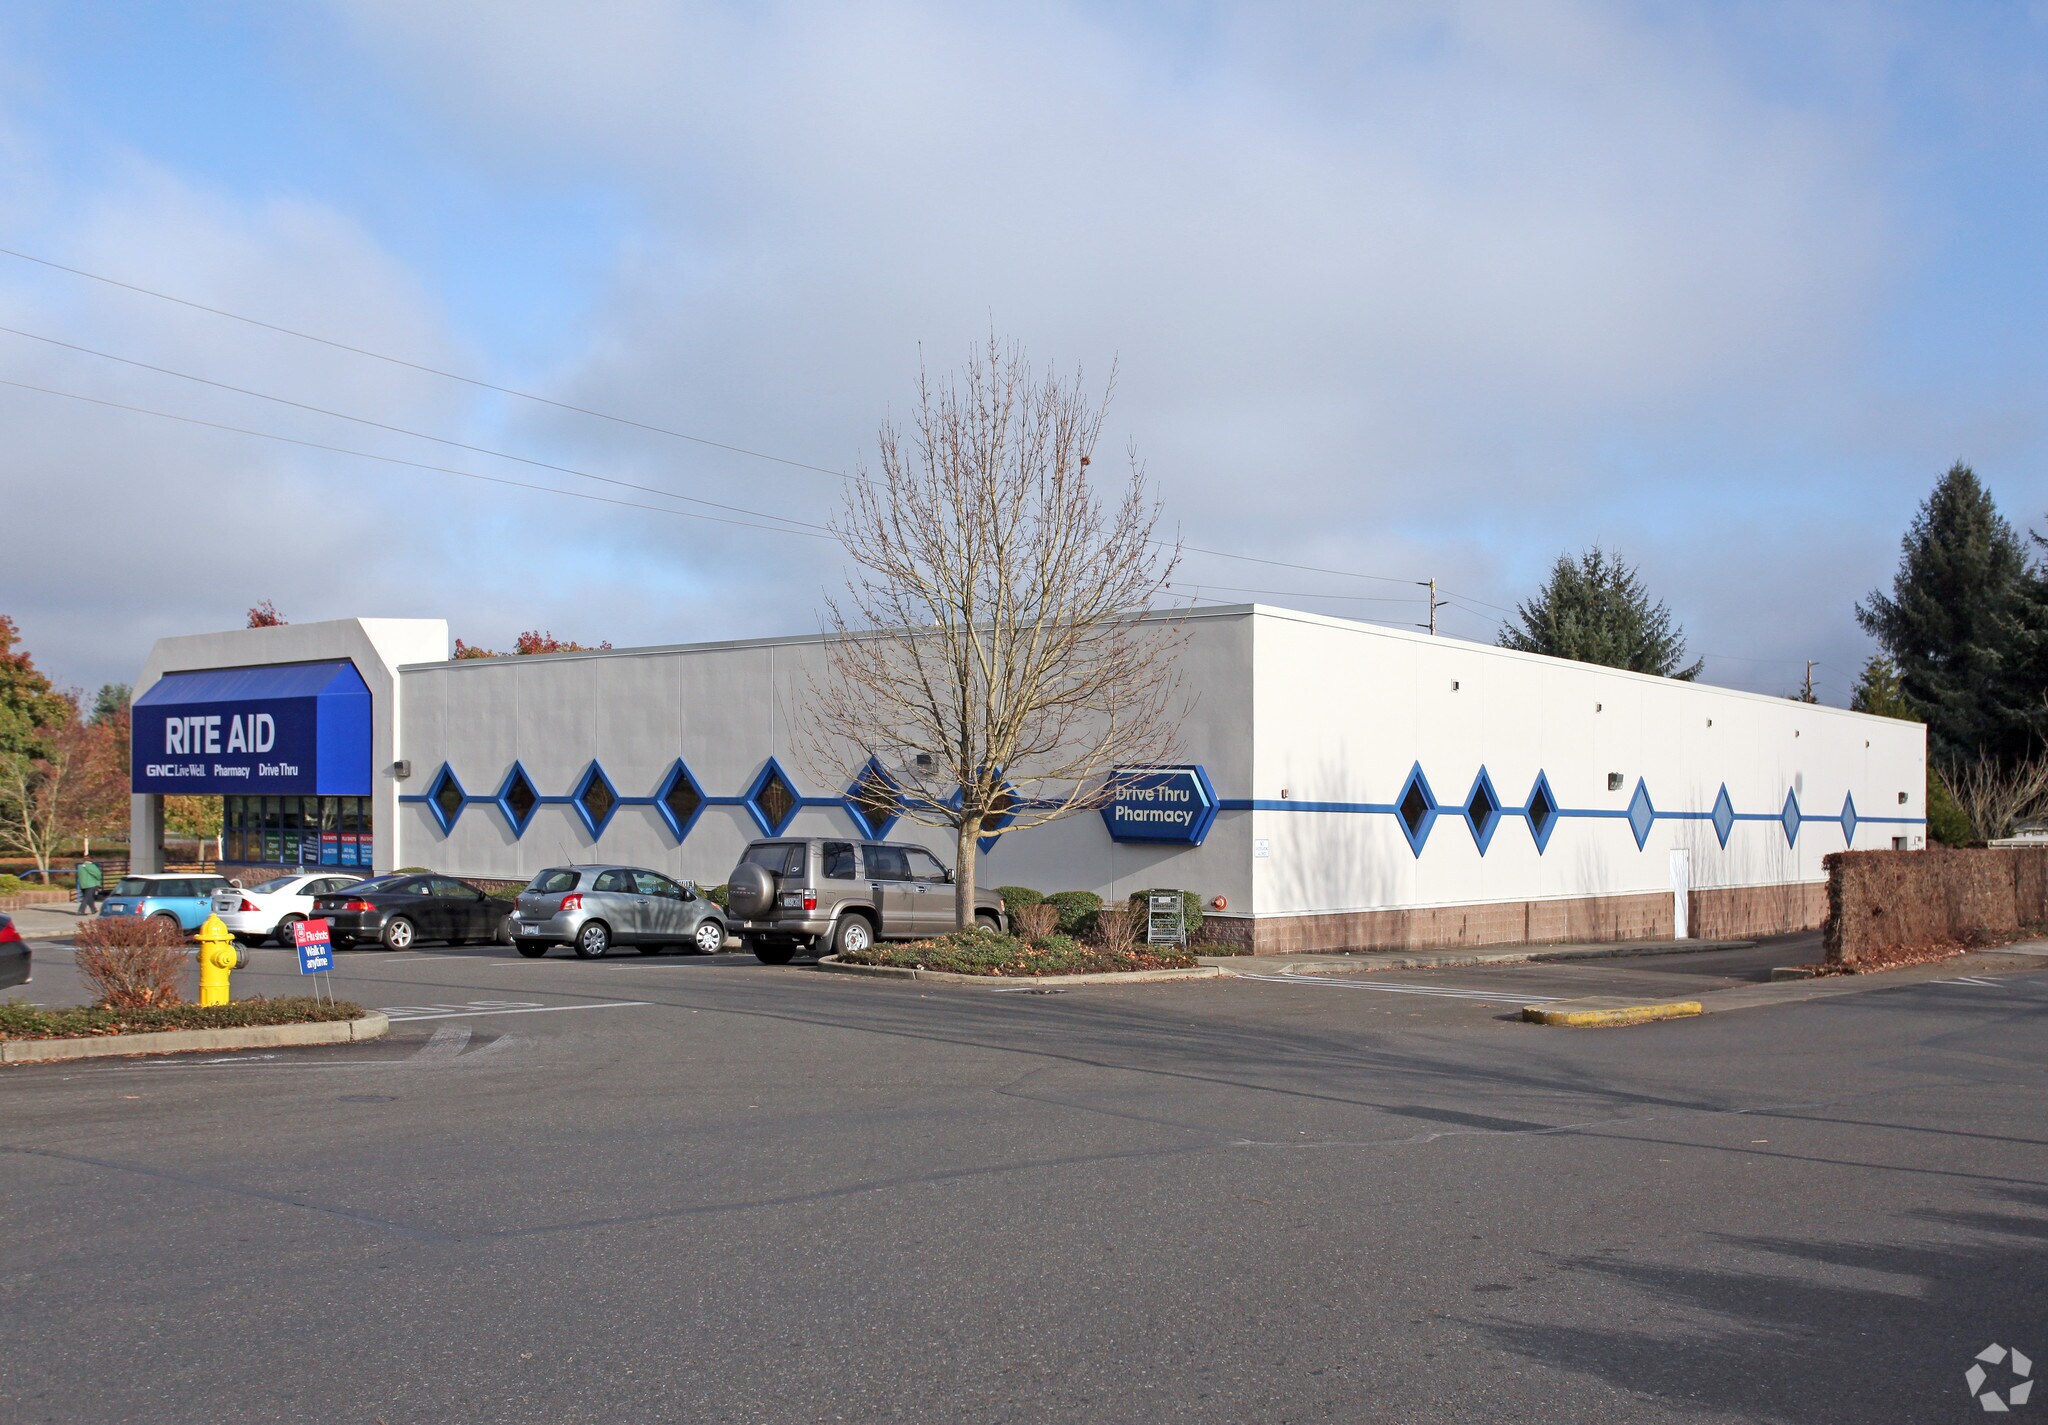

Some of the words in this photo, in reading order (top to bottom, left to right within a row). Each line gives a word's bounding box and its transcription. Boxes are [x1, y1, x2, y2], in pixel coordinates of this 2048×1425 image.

[166, 716, 221, 754] RITE
[227, 713, 275, 753] AID
[146, 764, 174, 777] GNC
[214, 764, 250, 779] Pharmacy
[258, 763, 279, 776] Drive
[279, 763, 298, 776] Thru
[1115, 785, 1155, 802] Drive
[1157, 786, 1190, 802] Thru
[1115, 805, 1194, 826] Pharmacy
[305, 931, 314, 941] Flu
[314, 930, 329, 941] shots
[305, 944, 320, 956] Walk
[319, 944, 326, 955] in
[306, 956, 329, 970] anytime
